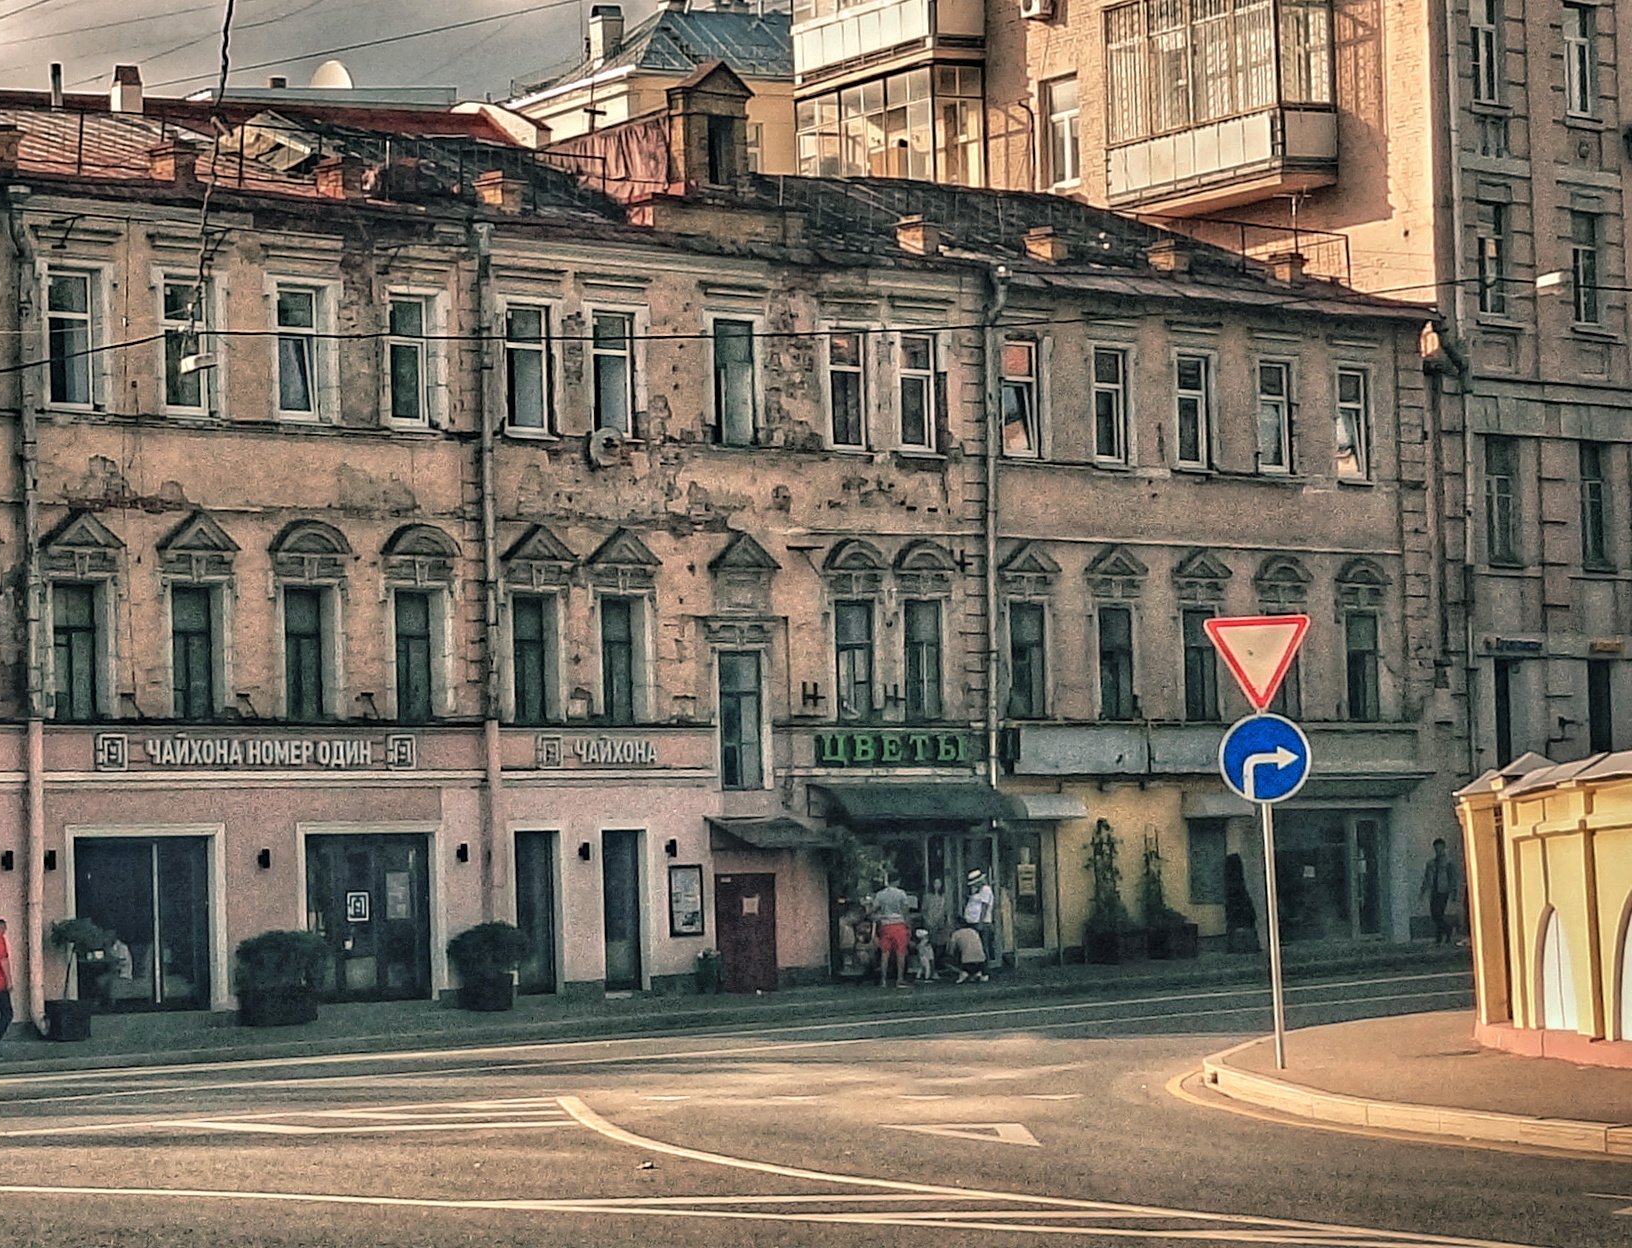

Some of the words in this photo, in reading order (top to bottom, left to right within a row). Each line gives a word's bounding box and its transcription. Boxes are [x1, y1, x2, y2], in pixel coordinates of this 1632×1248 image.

[148, 733, 242, 765] ЧАЙХОНА
[248, 739, 314, 765] НОМЕР
[318, 740, 372, 768] ОДИН
[573, 735, 657, 764] ЧАЙХОНА
[822, 734, 968, 766] ЦВЕТЫ
